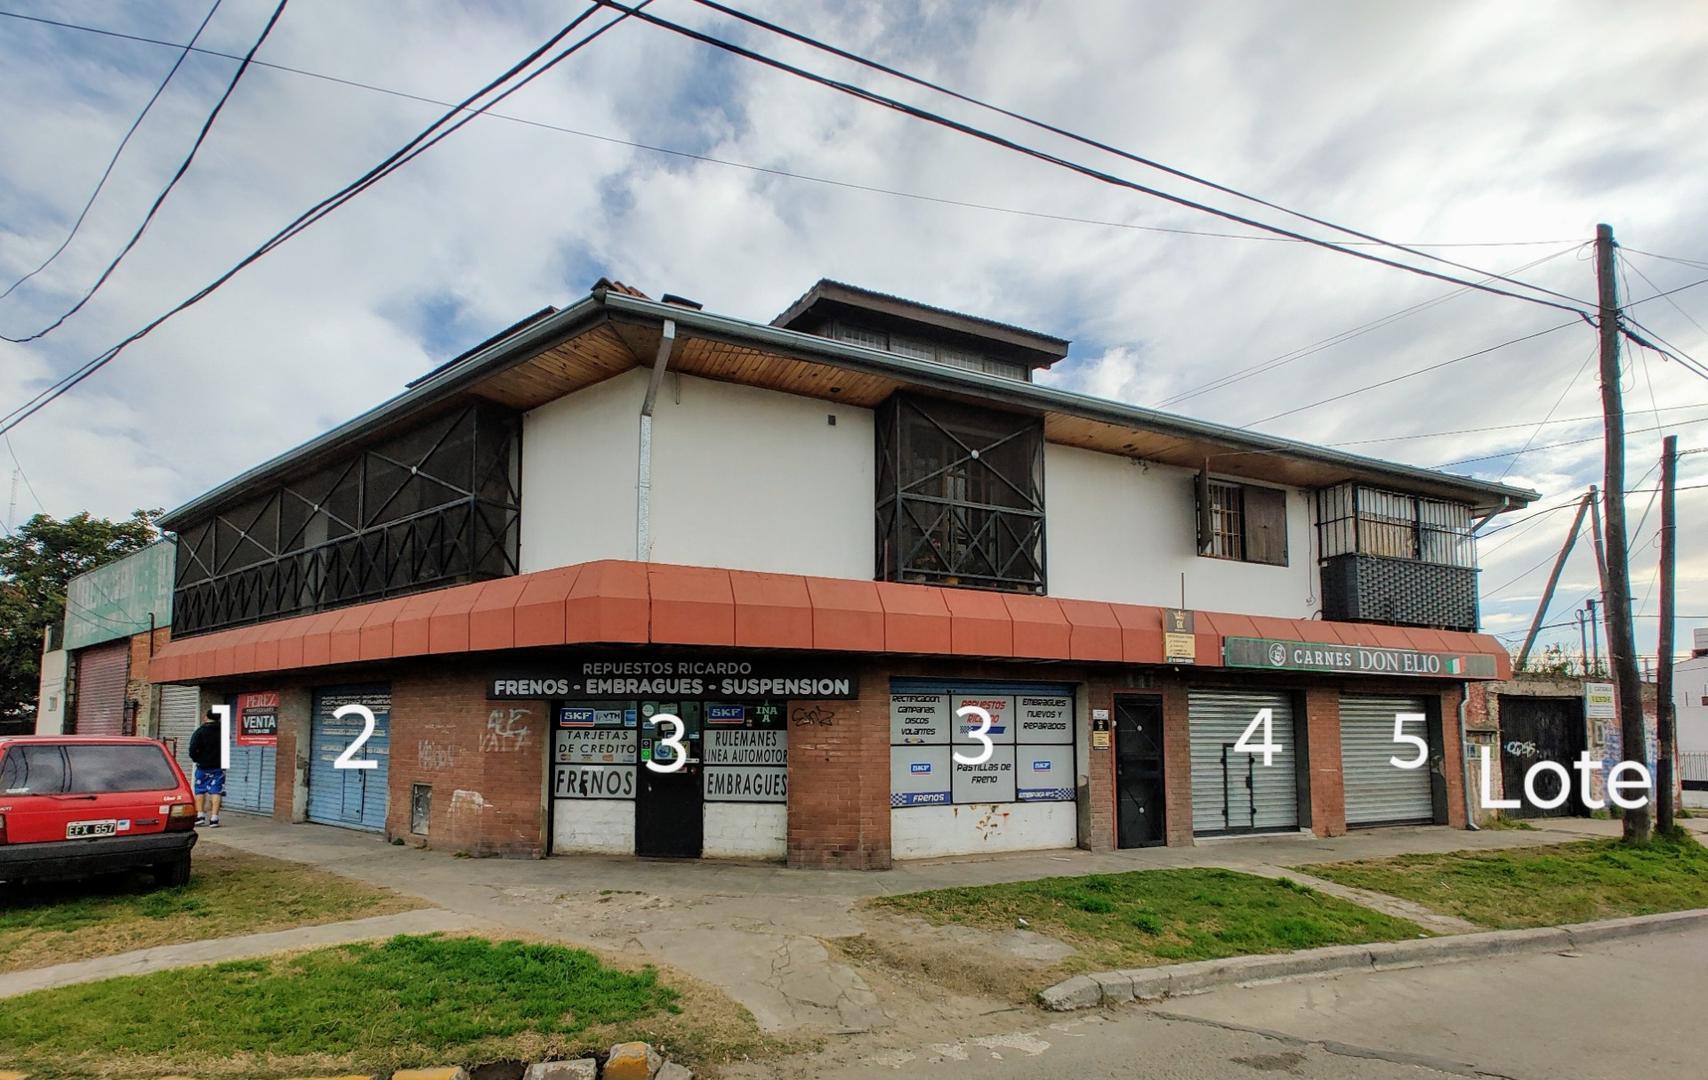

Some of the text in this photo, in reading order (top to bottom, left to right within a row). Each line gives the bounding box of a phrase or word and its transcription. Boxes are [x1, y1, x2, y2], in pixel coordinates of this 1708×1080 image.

[1294, 649, 1441, 674] CARNES DON ELIO
[583, 662, 752, 676] REPUESTOS RICARDO
[494, 679, 569, 696] FRENOS
[585, 678, 704, 695] EMBRAGUES
[721, 678, 850, 695] SUSPENSION
[564, 711, 592, 720] SKF
[711, 708, 741, 717] SKF
[756, 706, 777, 715] INA
[243, 715, 276, 729] VENTA
[567, 730, 629, 741] TARJETAS
[715, 731, 777, 746] RULEMANES
[559, 744, 637, 754] DE CREDITO
[731, 749, 788, 763] AUTOMOTOR
[556, 770, 634, 796] FRENOS
[707, 773, 787, 796] EMBRAGUES
[68, 822, 114, 836] EFX 657
